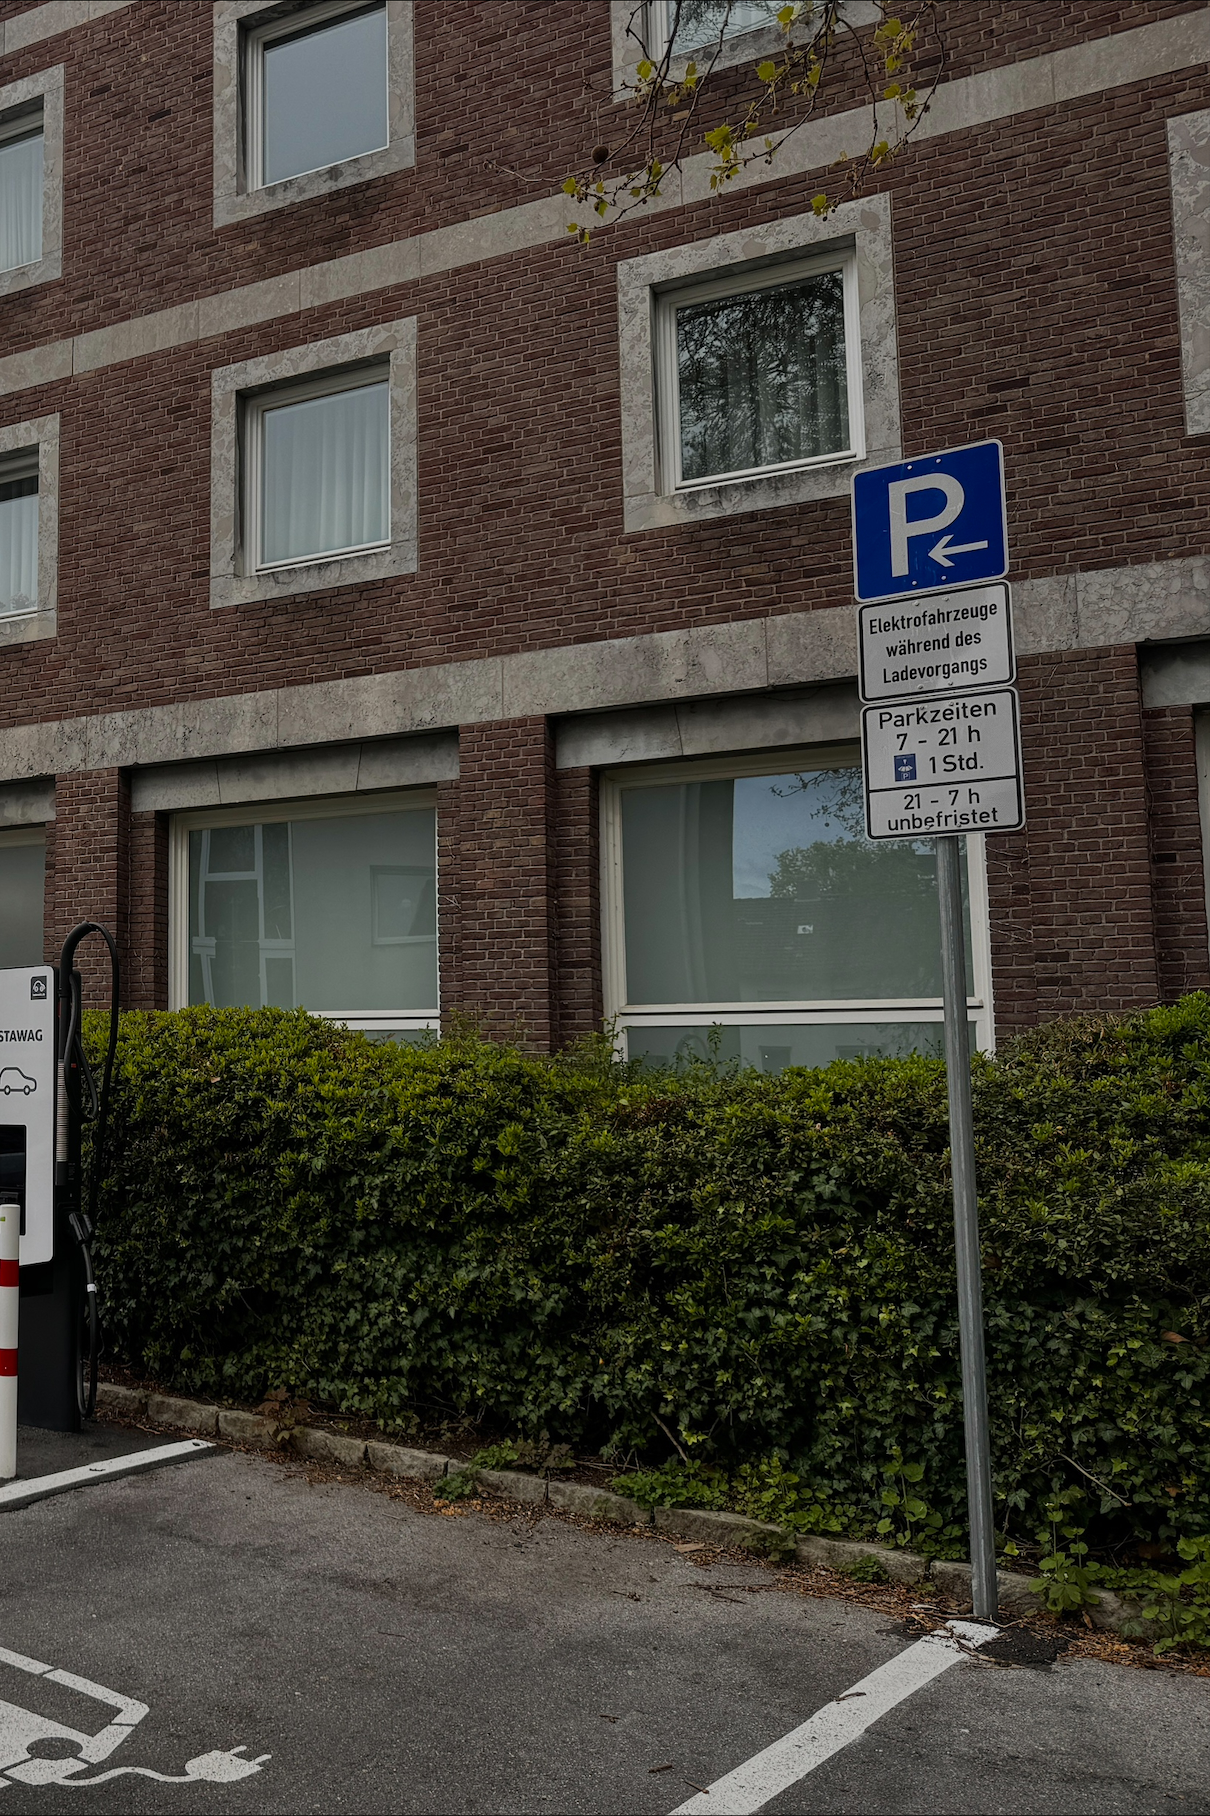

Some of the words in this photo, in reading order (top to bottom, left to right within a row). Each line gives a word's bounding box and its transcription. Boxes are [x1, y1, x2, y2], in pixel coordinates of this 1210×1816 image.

[888, 473, 965, 577] P
[869, 603, 998, 635] Elektrofahrzeuge
[886, 633, 950, 657] während
[955, 631, 982, 647] des
[883, 658, 988, 684] Ladevorgangs
[879, 702, 997, 730] Parkzeiten
[896, 733, 908, 751] 7
[938, 727, 957, 746] 21
[968, 725, 981, 743] h
[929, 757, 936, 774] 1
[943, 752, 984, 773] Std.
[904, 793, 921, 810] 21
[948, 790, 959, 806] 7
[969, 788, 980, 804] h
[888, 807, 999, 831] unbefristet
